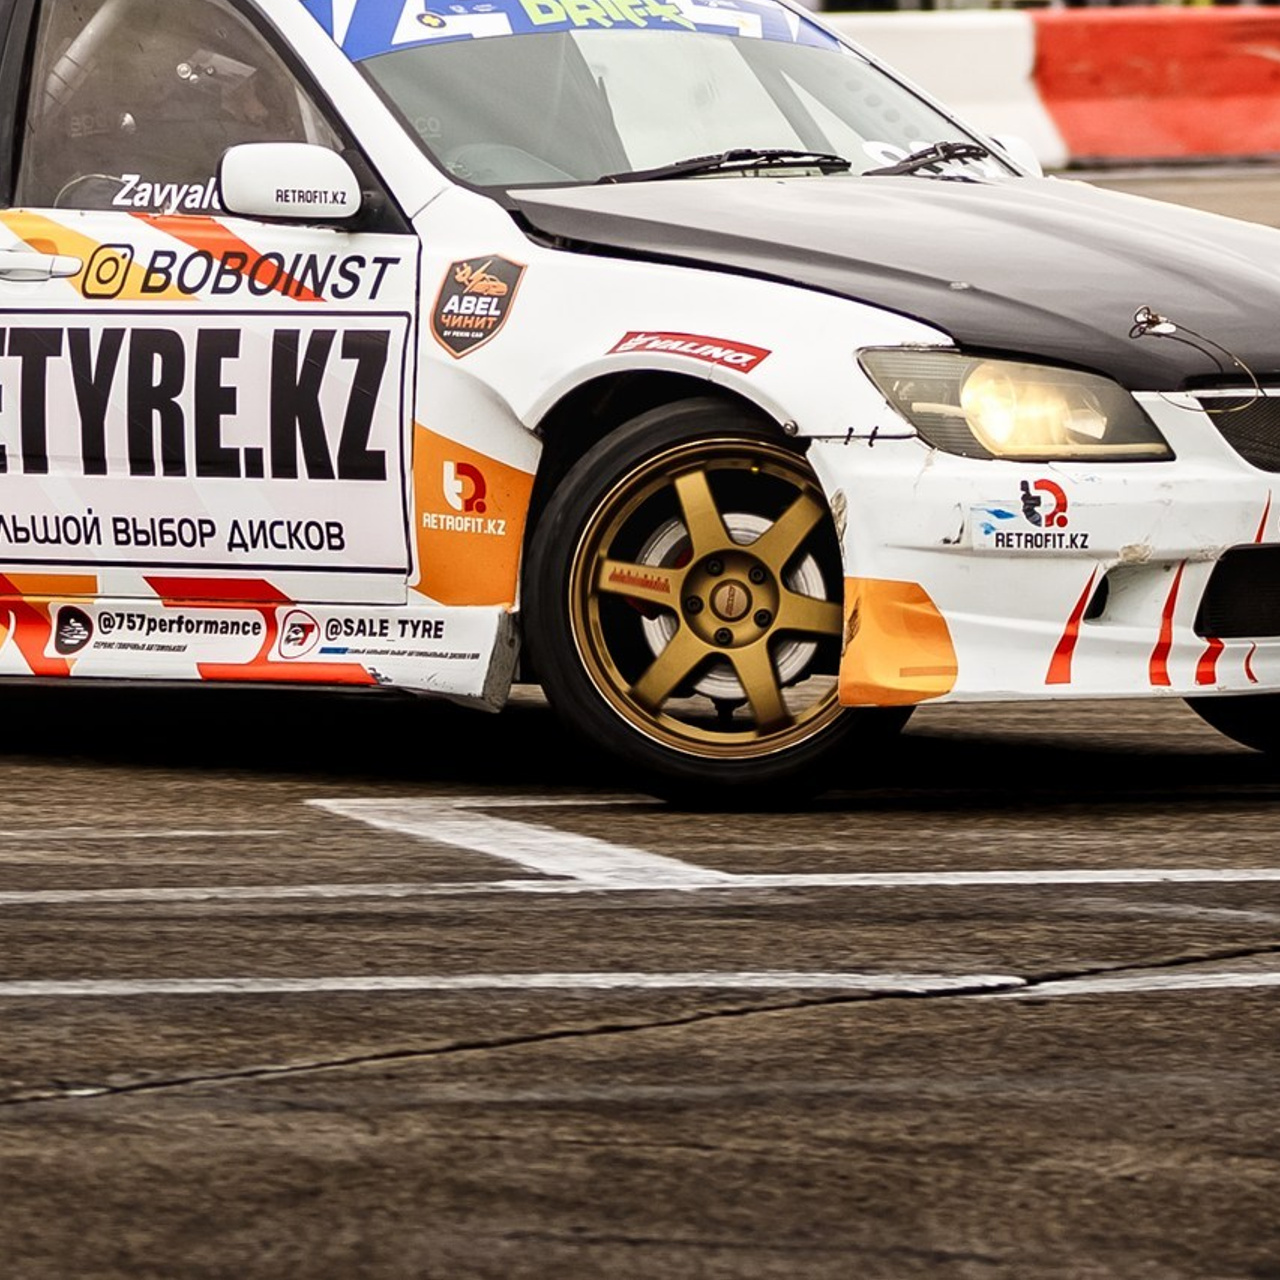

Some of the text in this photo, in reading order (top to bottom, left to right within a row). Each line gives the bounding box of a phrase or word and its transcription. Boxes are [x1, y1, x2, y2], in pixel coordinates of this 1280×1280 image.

[276, 189, 347, 205] RETROFIT.KZ
[140, 250, 401, 301] BOBOINST
[442, 294, 501, 316] ABEL
[441, 314, 498, 329] ЧИНИТ
[111, 517, 216, 548] ВЫБОР
[227, 519, 346, 553] ДИСКОВ
[423, 513, 506, 535] RETROFIT.KZ
[995, 532, 1089, 549] RETROFIT.KZ
[98, 611, 262, 636] @757performance
